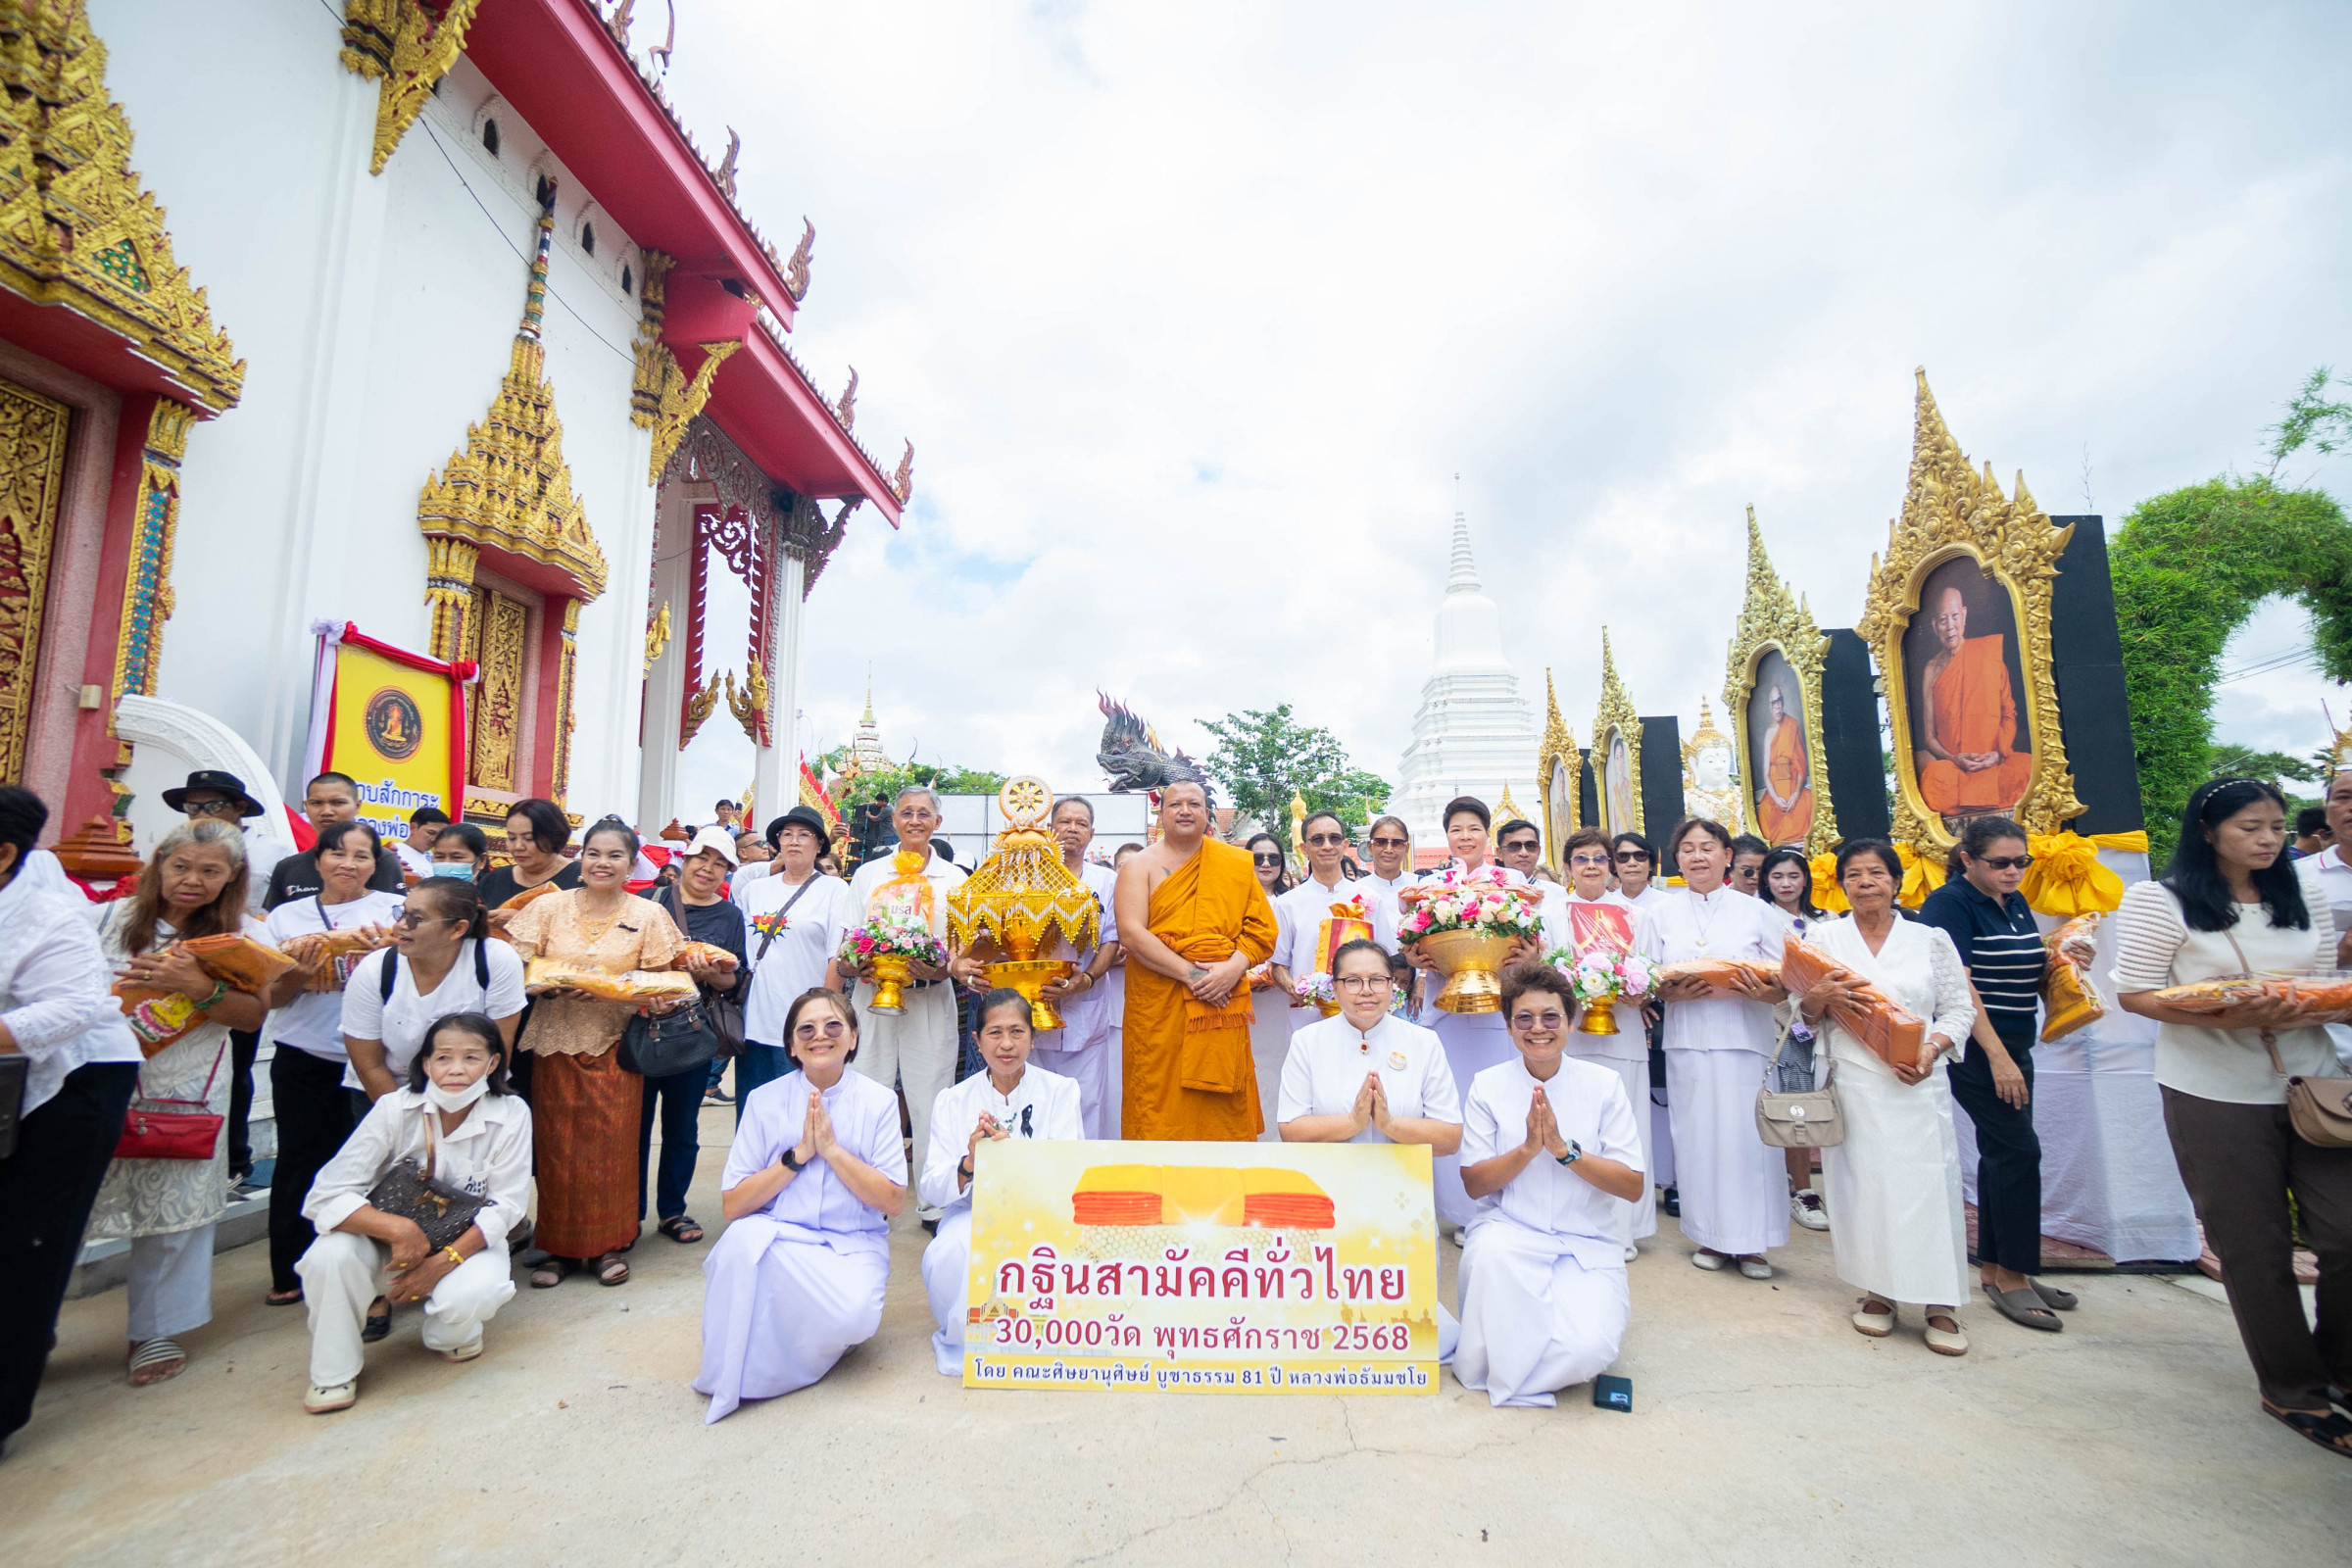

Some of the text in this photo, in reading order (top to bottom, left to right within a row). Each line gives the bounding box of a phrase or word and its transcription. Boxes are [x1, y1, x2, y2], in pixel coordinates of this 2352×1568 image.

[356, 780, 439, 808] าบสักการะ
[1000, 1237, 1404, 1309] กฐินสามัคคีทั่วไทย
[996, 1314, 1408, 1359] 30,000วัด พุทธศักราช 2568
[975, 1358, 1427, 1389] โดย คณะศิษยานุศิษย์ บูชาธรรม 81 ปี หลวงพ่อธัมมชโย
